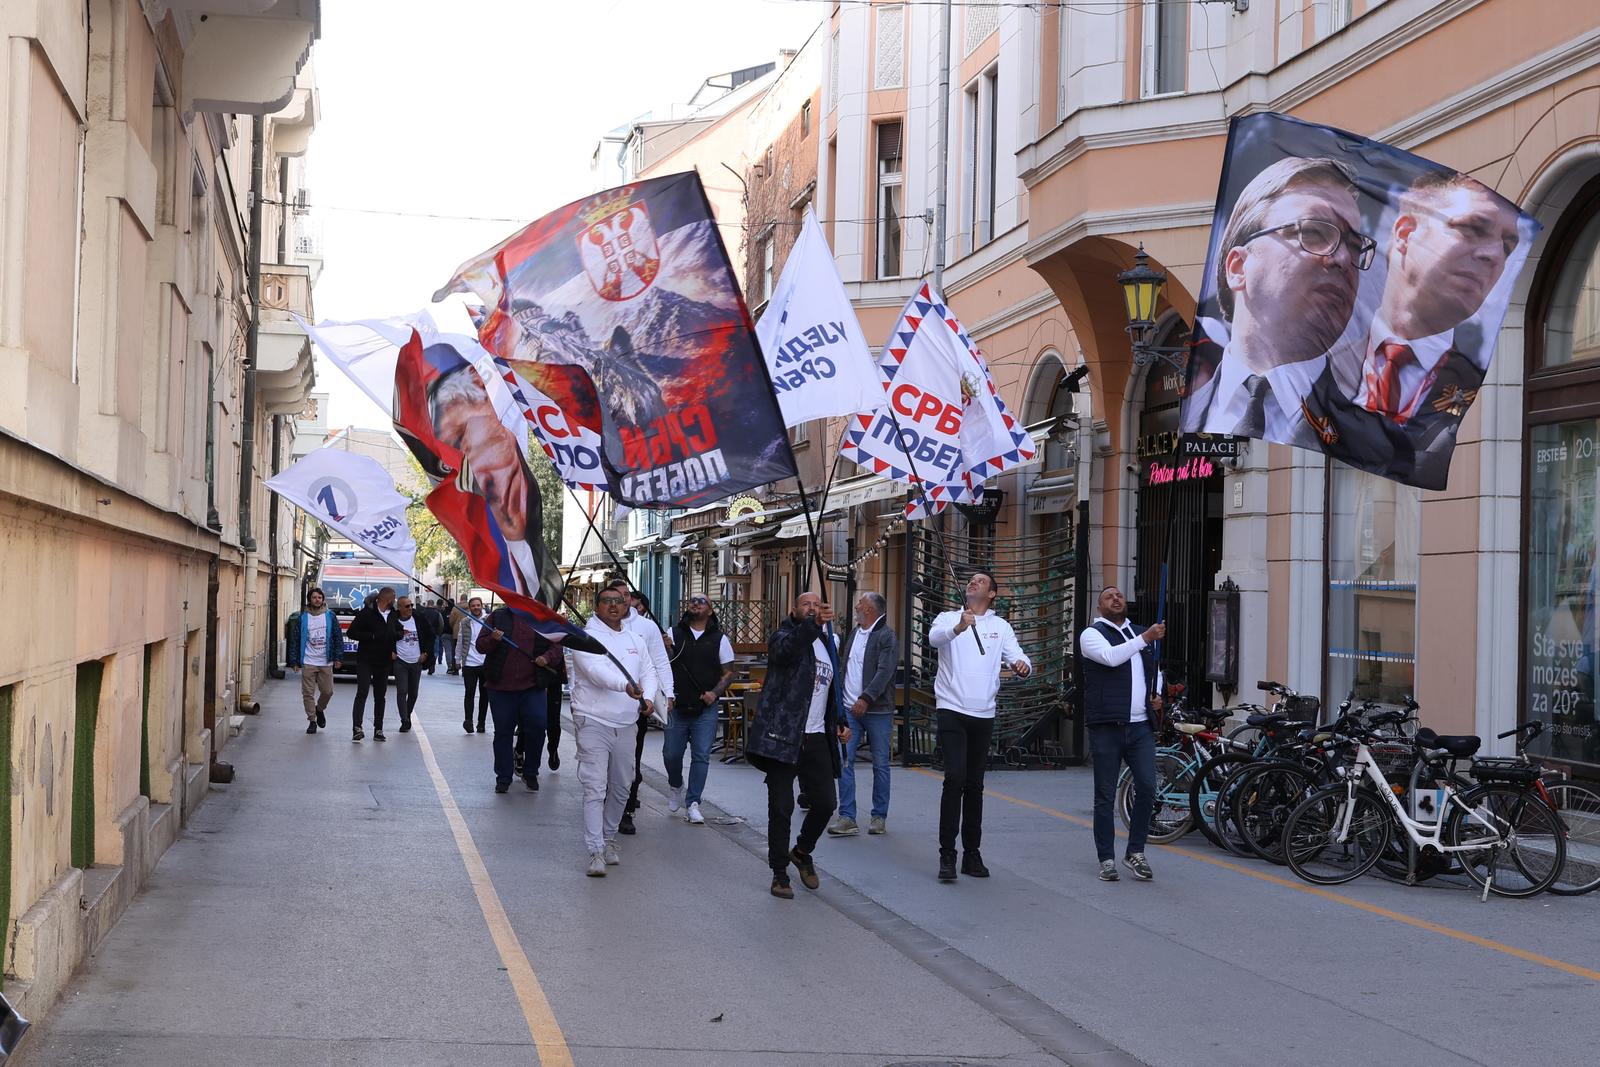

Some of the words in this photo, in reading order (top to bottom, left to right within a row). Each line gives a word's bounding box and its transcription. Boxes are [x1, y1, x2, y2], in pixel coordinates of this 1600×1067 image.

[892, 384, 963, 439] СРБ
[551, 441, 600, 470] ПО
[1185, 442, 1235, 453] PALACE
[1537, 448, 1559, 463] ERSTE
[1576, 437, 1593, 459] 20
[1533, 625, 1555, 656] Šta
[1560, 640, 1584, 658] sve
[1532, 660, 1578, 687] možeš
[1532, 693, 1548, 713] za
[1552, 689, 1579, 715] 20?
